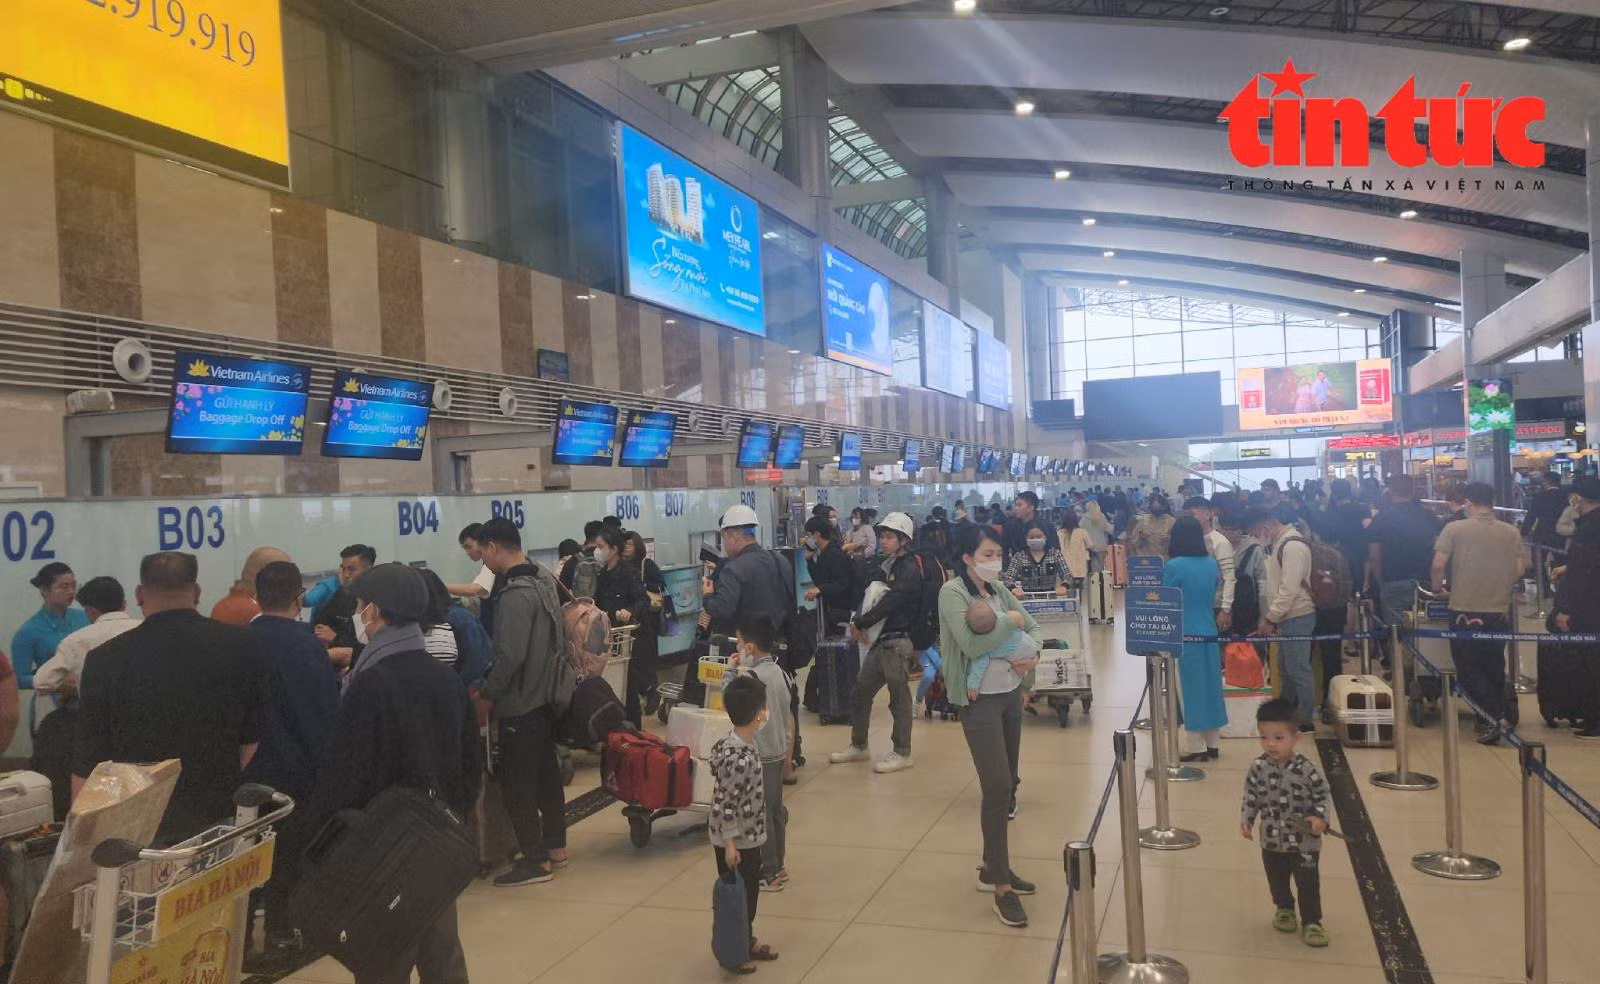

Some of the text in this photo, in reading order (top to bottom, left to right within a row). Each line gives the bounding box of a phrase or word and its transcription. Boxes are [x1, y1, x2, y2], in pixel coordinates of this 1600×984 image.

[86, 0, 255, 67] .919.919
[200, 410, 285, 426] Baggage Drop Off
[348, 420, 411, 436] Baggage Drop Off
[615, 495, 640, 520] B06
[665, 492, 684, 516] B07
[740, 490, 756, 511] B08
[398, 501, 439, 535] B04
[491, 500, 525, 529] B05
[157, 506, 225, 551] B03
[173, 886, 204, 921] BIA
